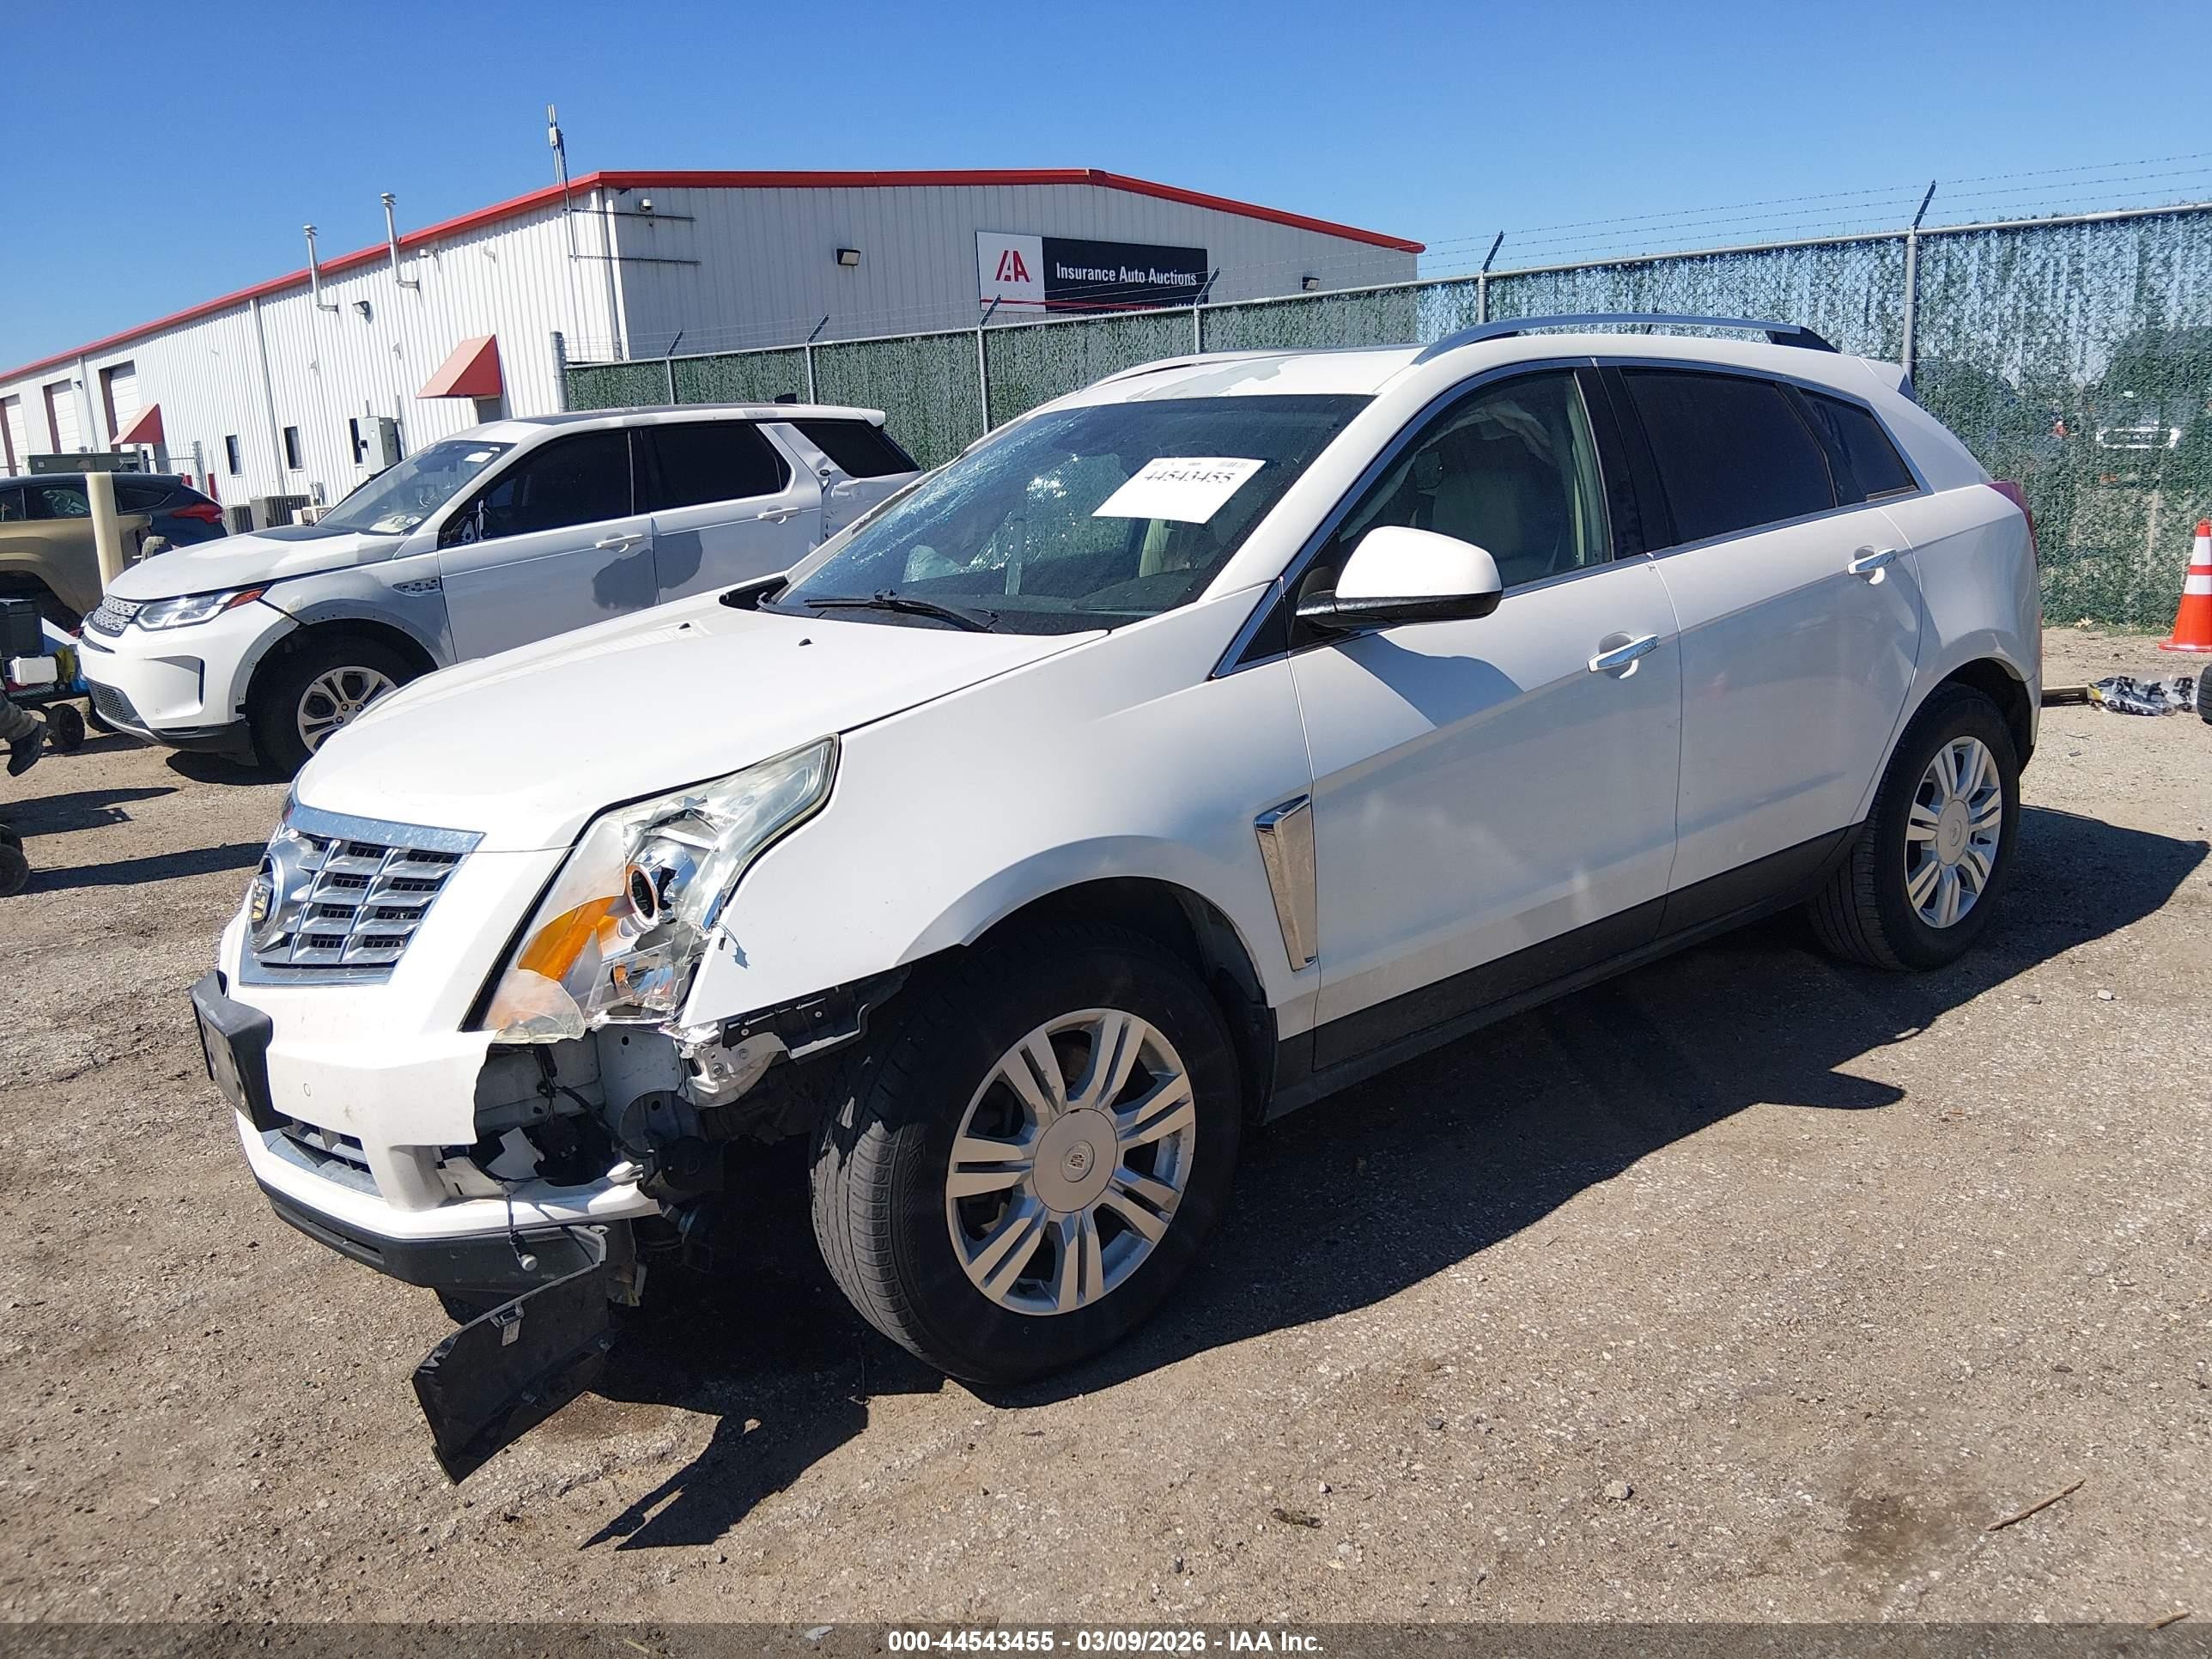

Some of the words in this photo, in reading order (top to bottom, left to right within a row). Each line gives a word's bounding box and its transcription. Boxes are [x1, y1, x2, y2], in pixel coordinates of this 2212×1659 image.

[1056, 262, 1115, 282] Insurance
[1119, 266, 1146, 283] Auto
[1148, 267, 1196, 286] Auctions
[1145, 471, 1235, 483] 44543455
